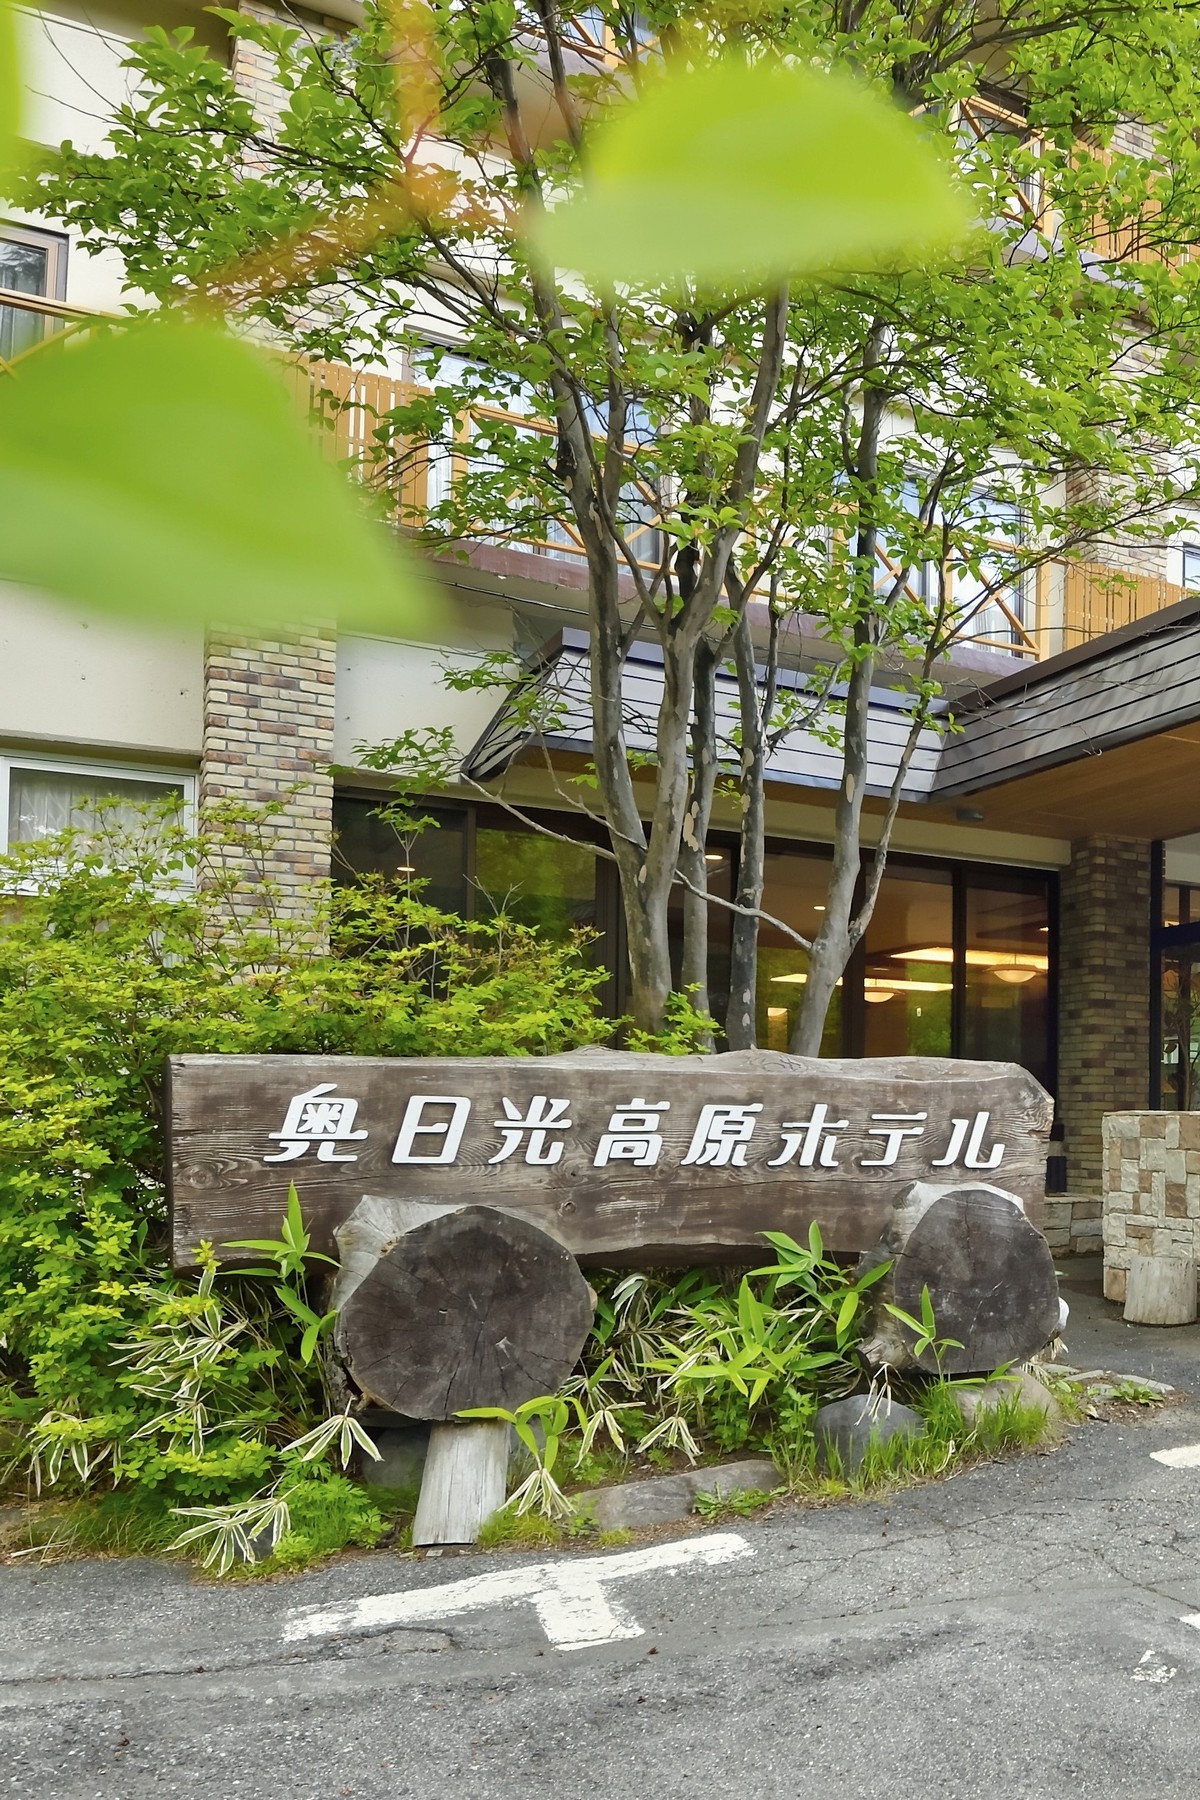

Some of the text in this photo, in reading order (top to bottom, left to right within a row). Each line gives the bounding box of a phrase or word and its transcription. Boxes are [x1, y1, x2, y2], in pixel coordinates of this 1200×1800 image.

[263, 1083, 1006, 1169] 奥日光高原ホテル
